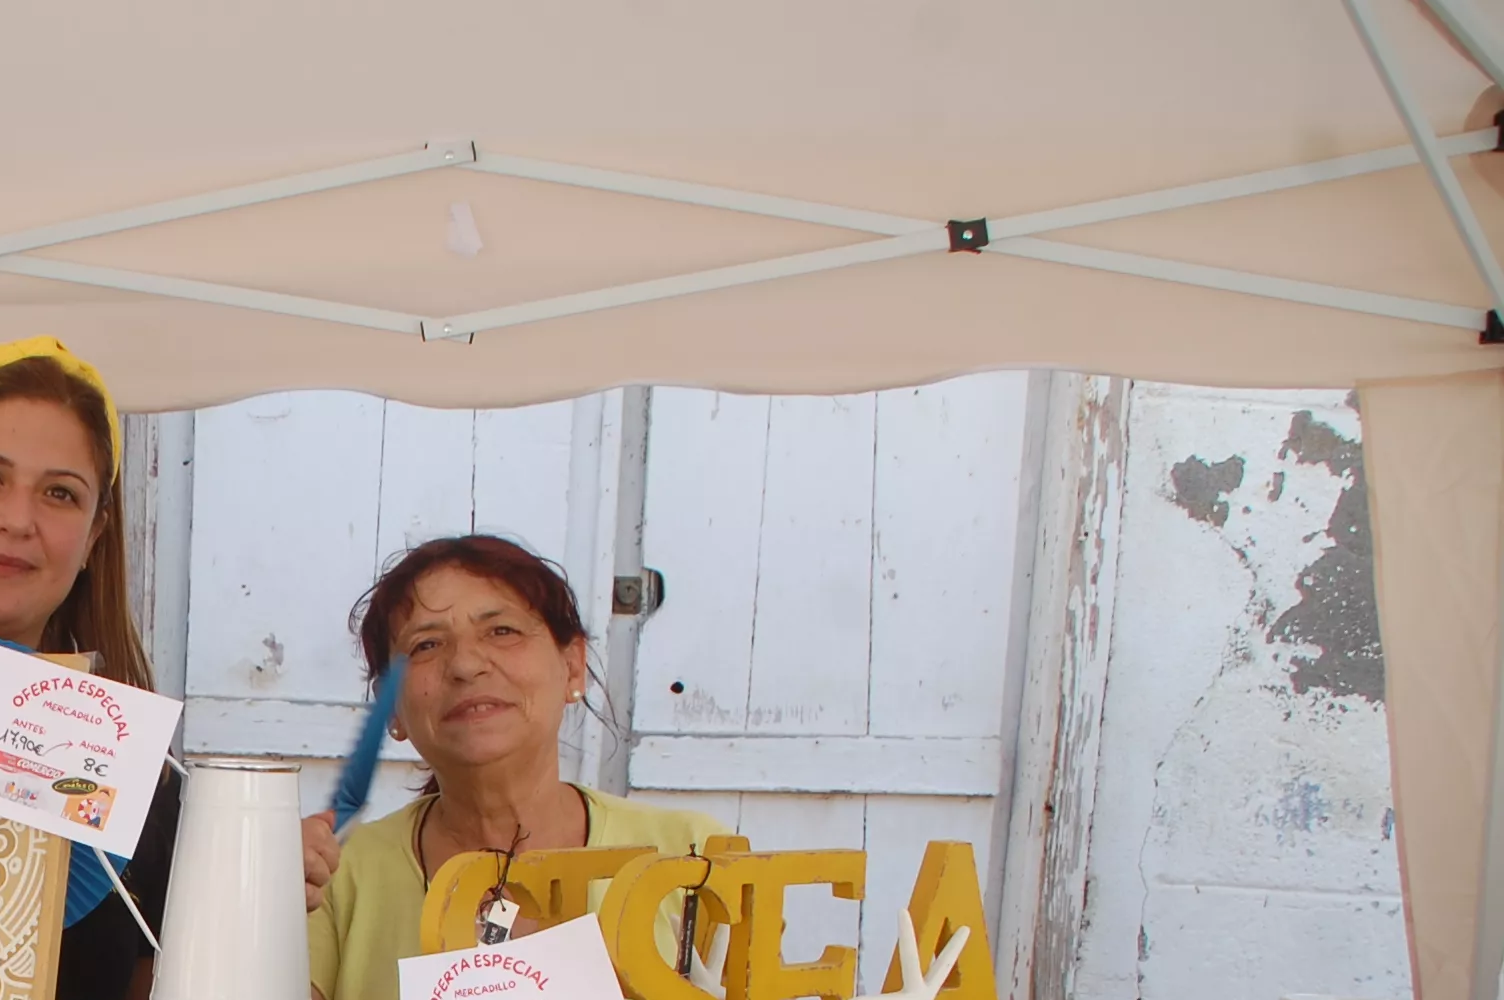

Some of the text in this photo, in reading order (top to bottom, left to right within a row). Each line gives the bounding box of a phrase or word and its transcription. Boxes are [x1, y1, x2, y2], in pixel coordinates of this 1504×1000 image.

[12, 677, 131, 742] OFERTA ESPECIAL
[42, 699, 103, 726] MERCADILLO
[83, 757, 109, 777] 8€
[473, 953, 551, 992] ESPECIAL
[454, 980, 517, 999] MERCADILLO
